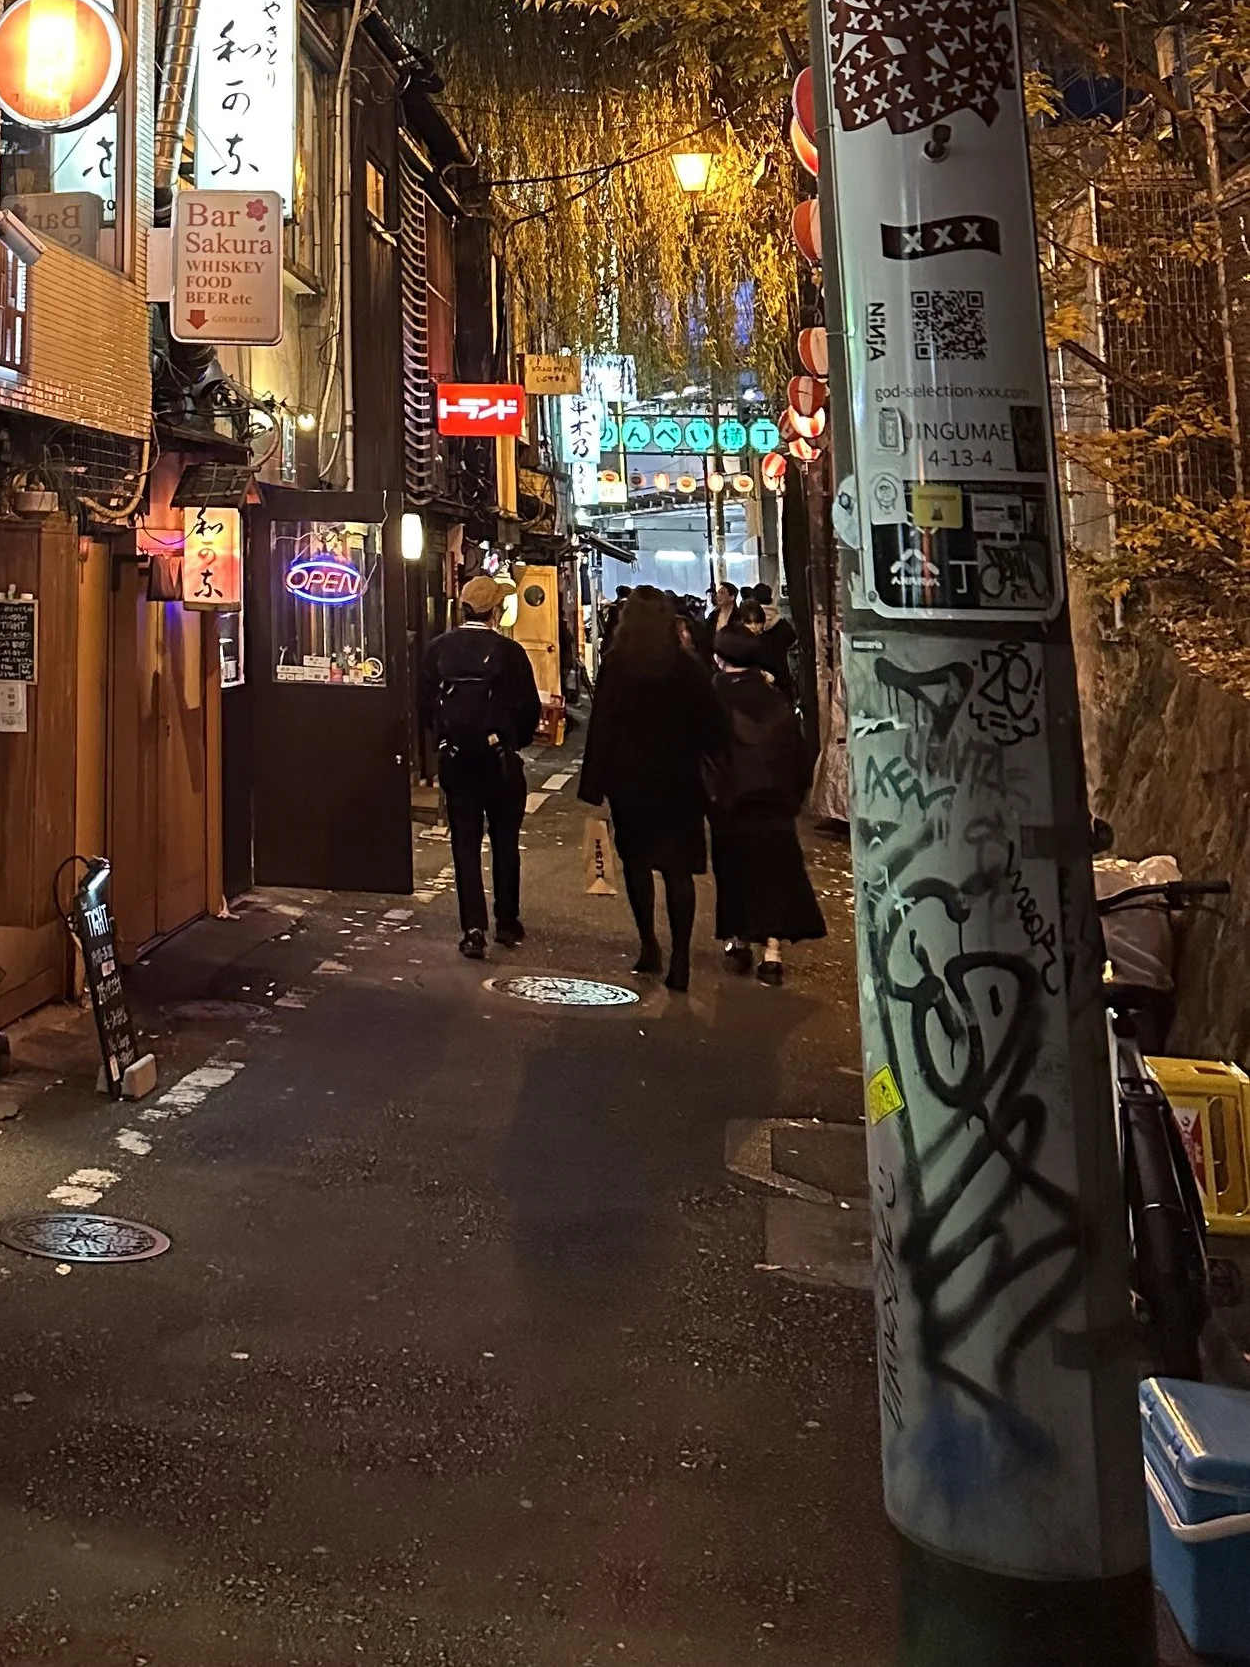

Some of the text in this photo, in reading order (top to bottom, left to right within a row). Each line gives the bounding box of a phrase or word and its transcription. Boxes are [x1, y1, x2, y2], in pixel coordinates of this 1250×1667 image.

[262, 0, 281, 89] やきとり
[186, 202, 241, 228] Bar
[185, 231, 273, 255] Sakura
[186, 260, 265, 274] WHISKEY
[186, 276, 232, 289] FOOD
[185, 291, 252, 305] BEER etc
[875, 384, 1030, 403] god-selection-xxx.com
[439, 398, 518, 421] トランド
[928, 449, 994, 468] 4-13-4
[285, 569, 362, 595] OPEN
